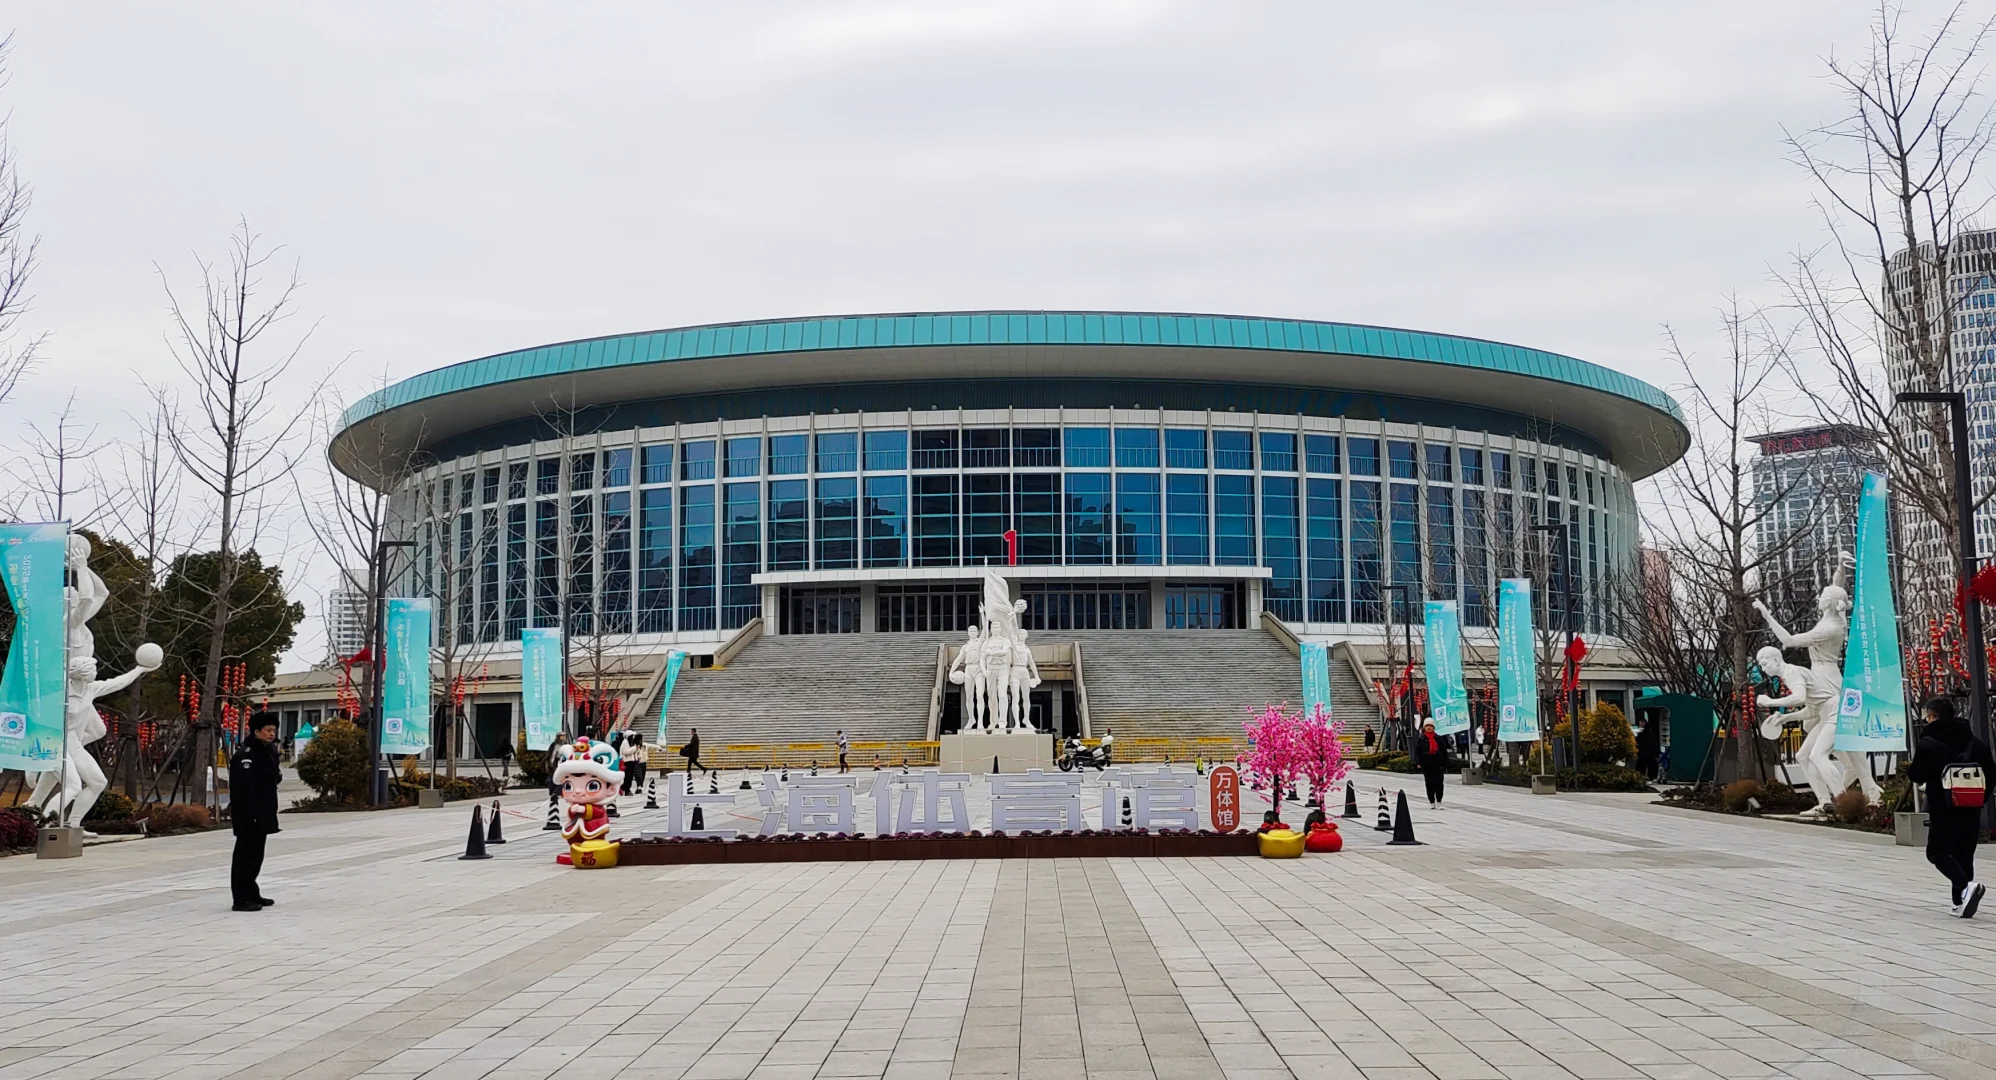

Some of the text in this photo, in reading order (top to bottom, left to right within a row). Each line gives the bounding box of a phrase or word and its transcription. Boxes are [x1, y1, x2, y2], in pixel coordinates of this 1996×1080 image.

[1002, 529, 1017, 567] 1
[641, 766, 1199, 837] 上海体育馆
[1216, 772, 1234, 826] 万体馆
